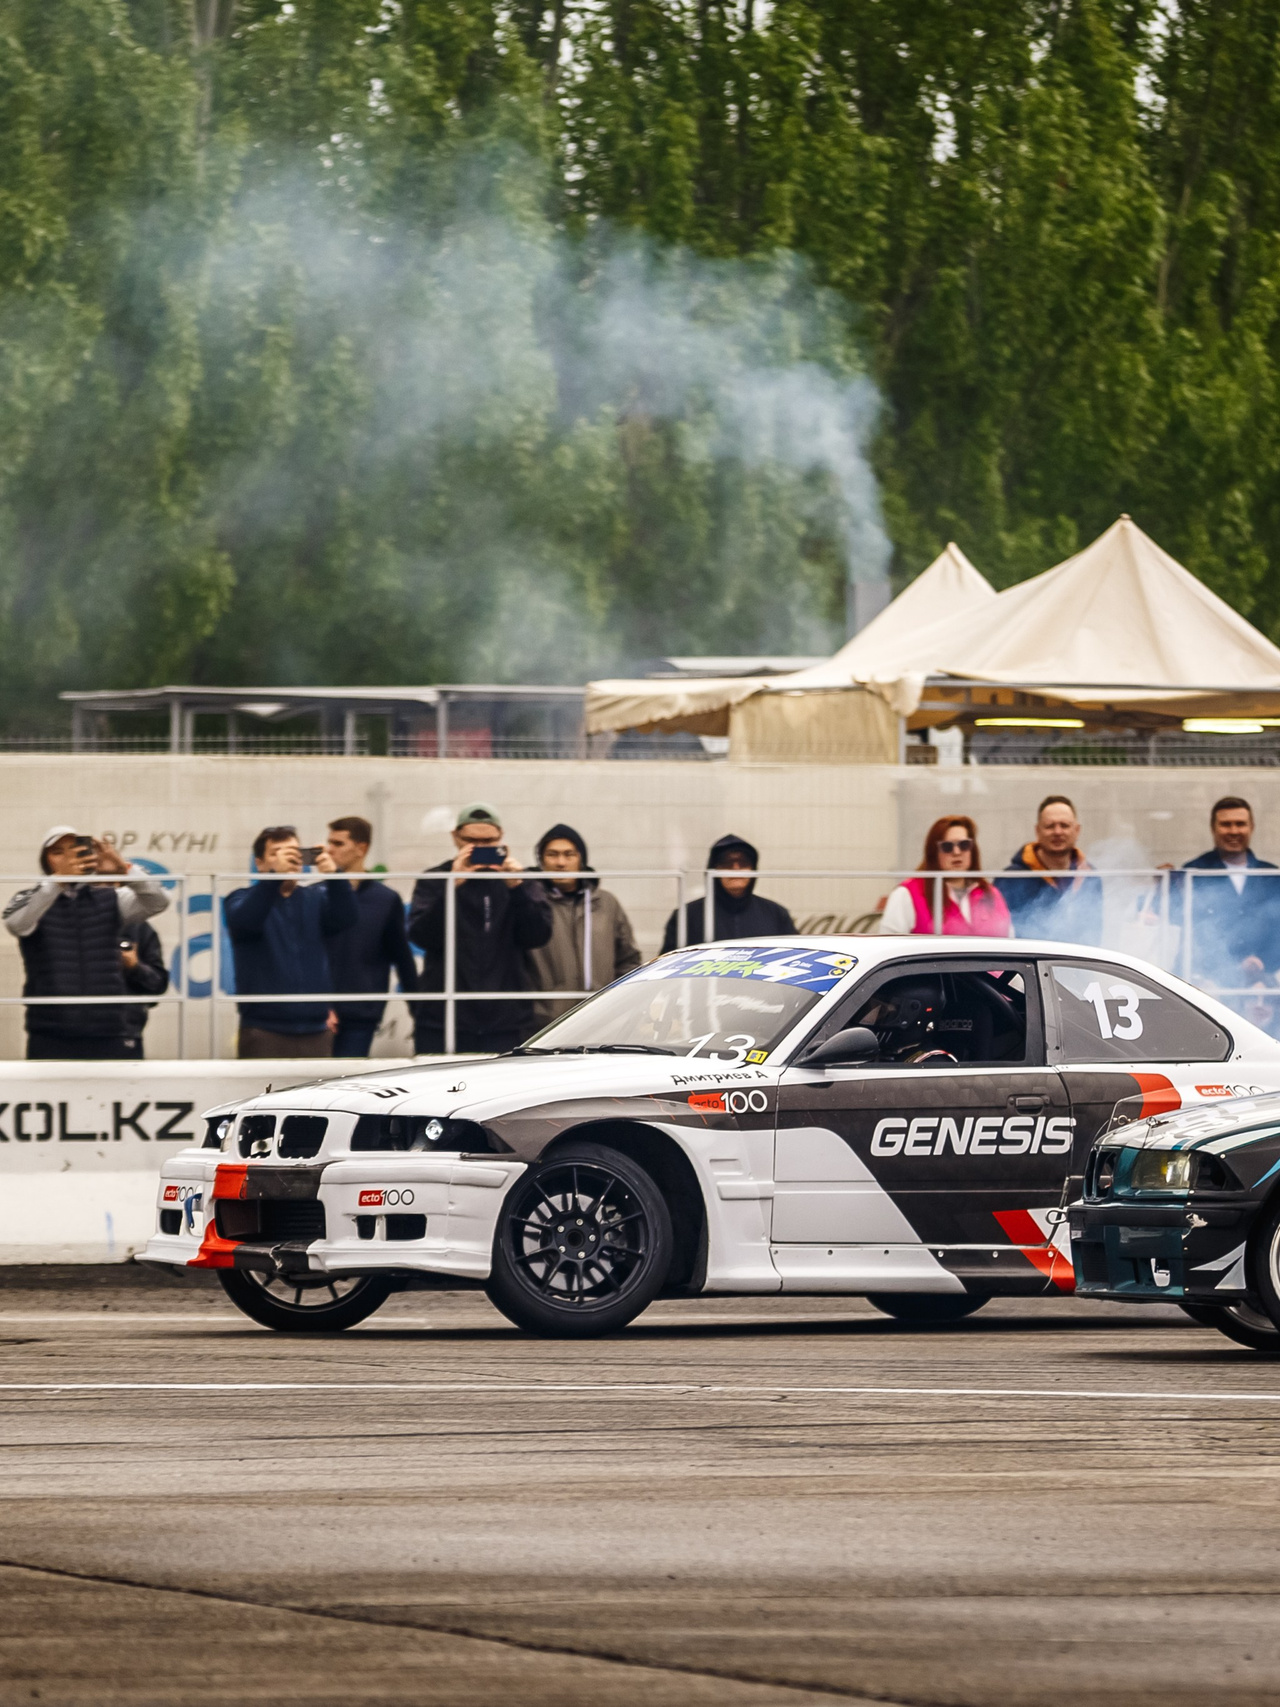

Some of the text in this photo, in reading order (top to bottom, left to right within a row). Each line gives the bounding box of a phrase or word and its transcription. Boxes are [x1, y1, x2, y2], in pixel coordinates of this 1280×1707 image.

[1083, 982, 1143, 1040] 13
[686, 1032, 756, 1064] 13
[670, 1072, 752, 1086] Дмитриев
[870, 1116, 1077, 1157] GENESIS
